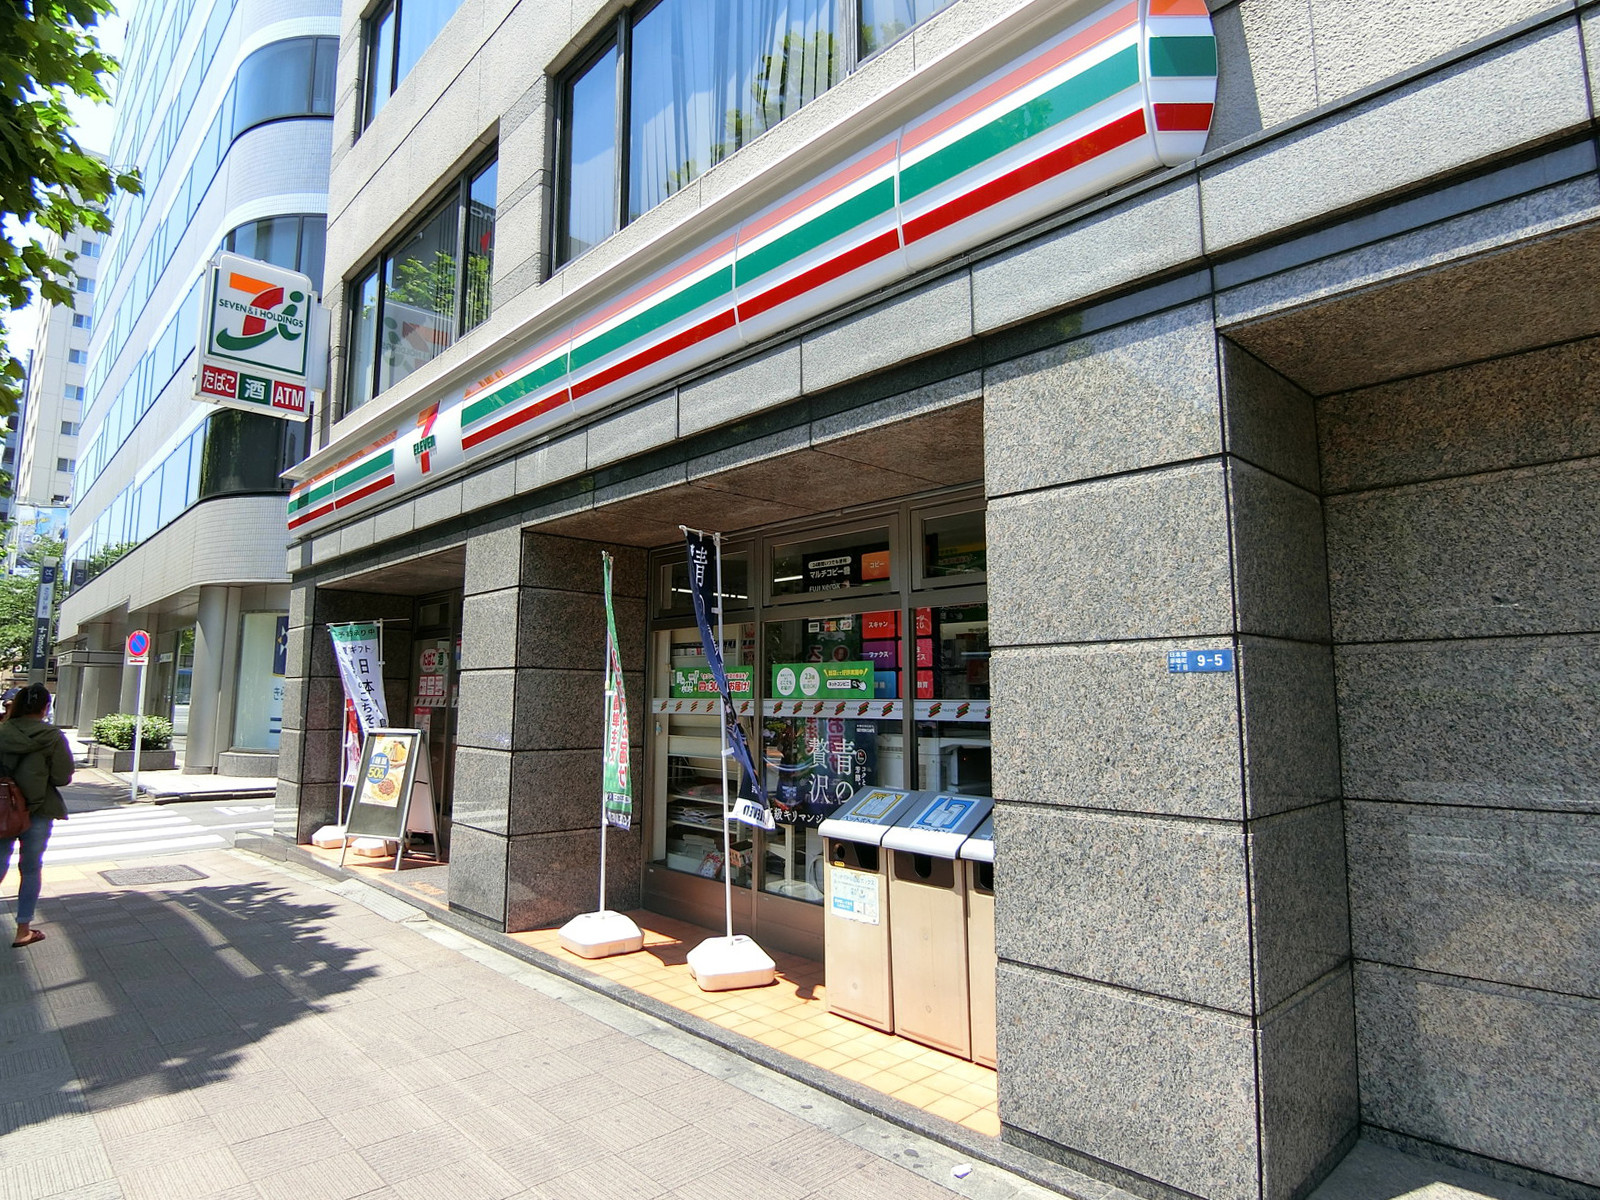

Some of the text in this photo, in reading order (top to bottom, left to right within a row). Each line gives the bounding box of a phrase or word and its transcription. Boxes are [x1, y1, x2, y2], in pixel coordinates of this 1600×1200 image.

[259, 309, 304, 328] HOLDINGS
[203, 370, 235, 393] たばこ
[245, 378, 266, 400] 酒
[275, 387, 303, 408] ATM
[869, 561, 885, 569] コピー
[868, 620, 889, 628] スキャン
[1197, 654, 1223, 667] 9-5
[808, 738, 831, 804] 贅沢
[832, 738, 857, 803] 青の
[769, 807, 824, 824] 級キリマンジ
